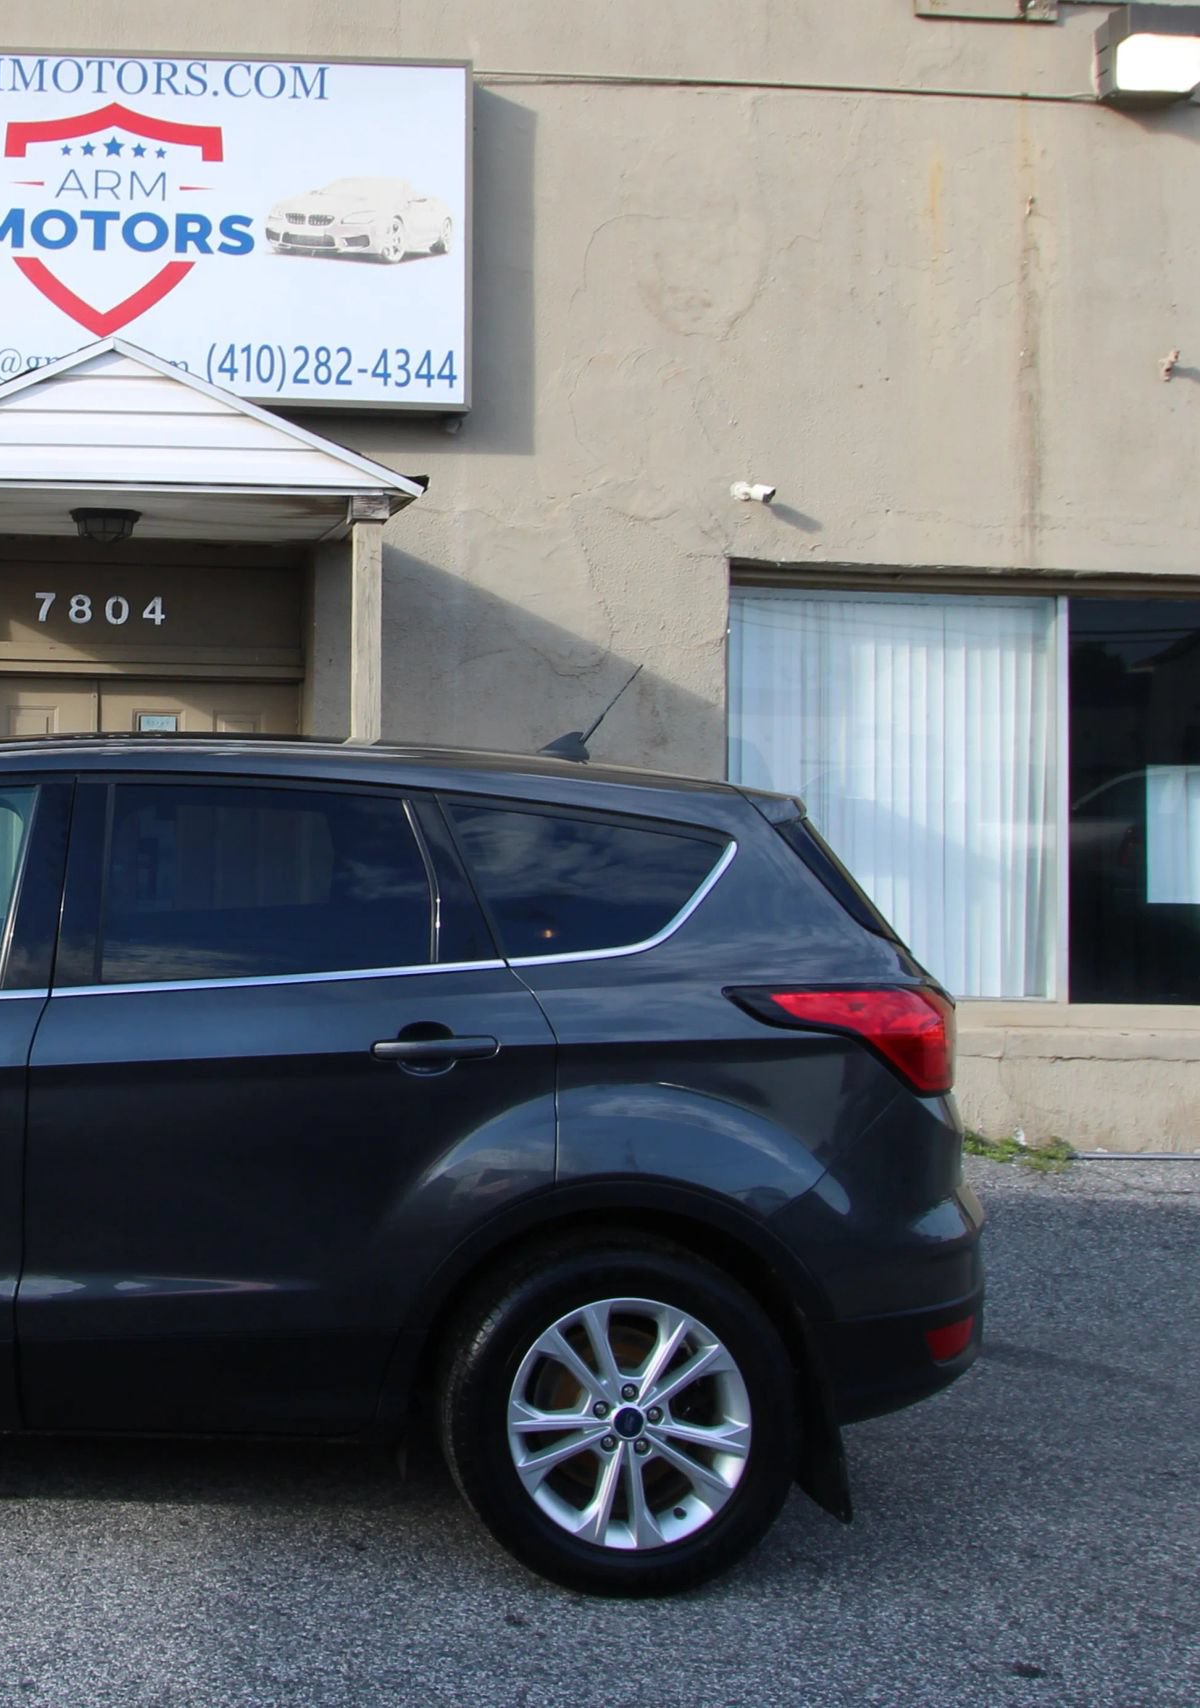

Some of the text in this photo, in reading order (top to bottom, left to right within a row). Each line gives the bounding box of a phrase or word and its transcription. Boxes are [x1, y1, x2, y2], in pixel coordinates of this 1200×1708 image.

[54, 167, 168, 201] ARM
[205, 341, 459, 393] (410)282-4344
[34, 592, 166, 625] 7804
